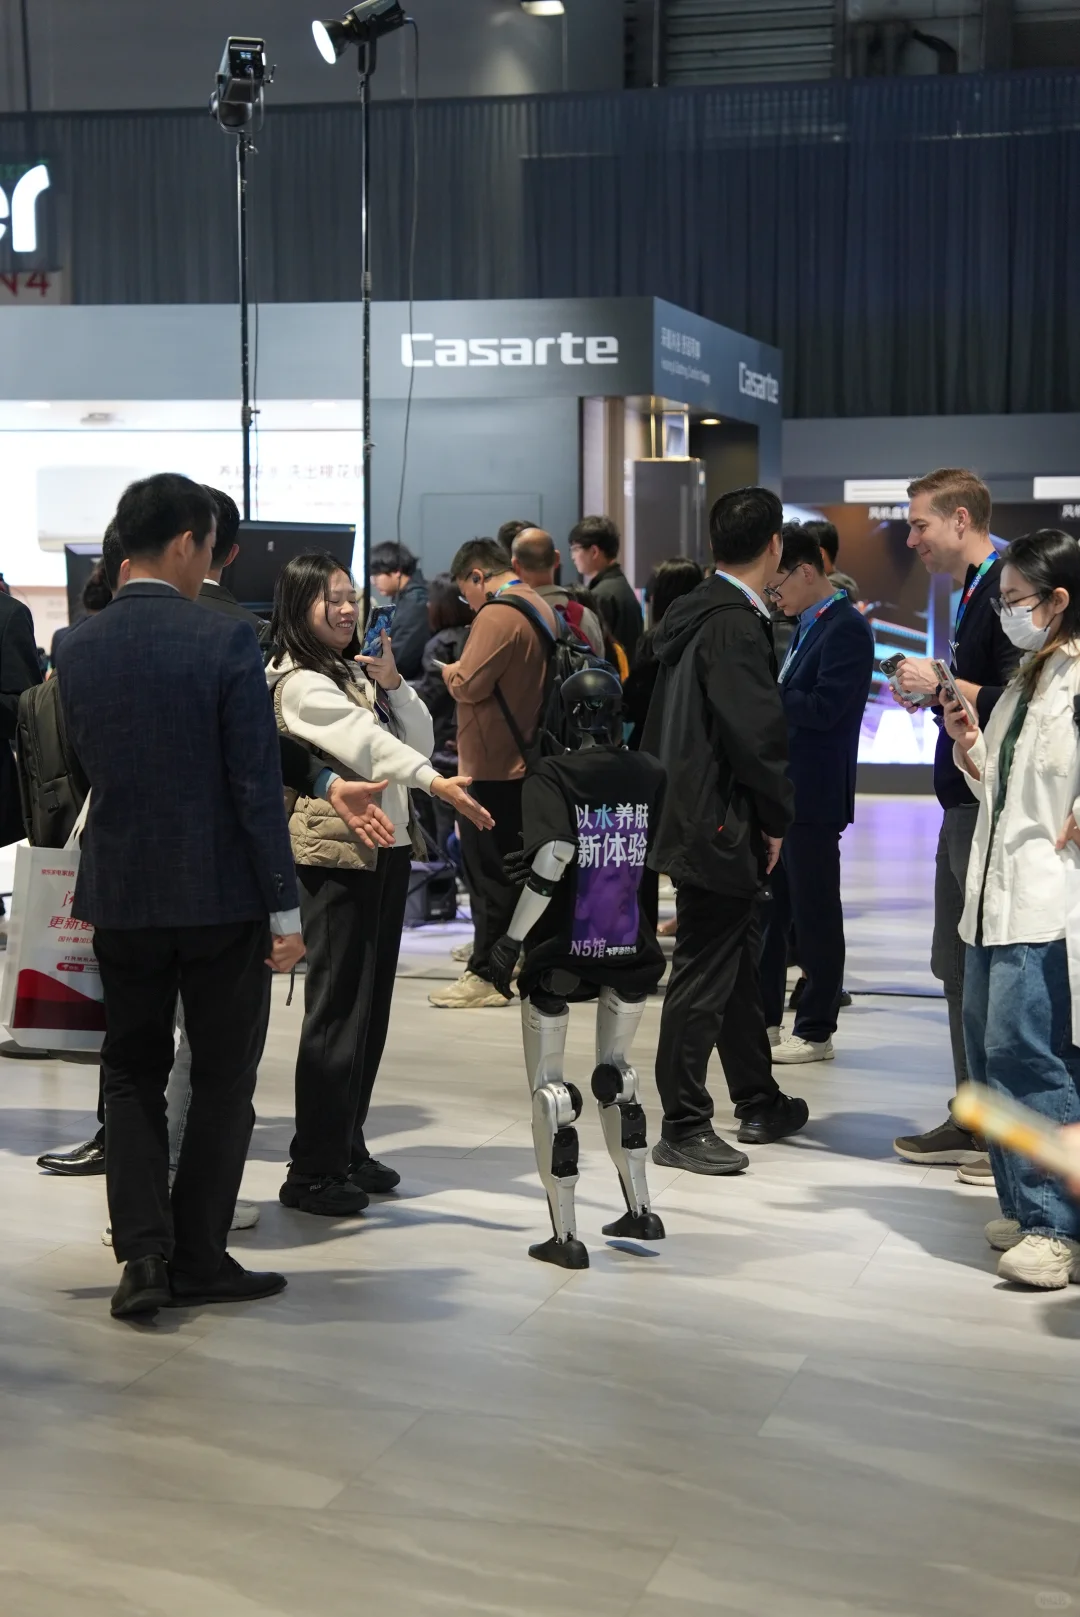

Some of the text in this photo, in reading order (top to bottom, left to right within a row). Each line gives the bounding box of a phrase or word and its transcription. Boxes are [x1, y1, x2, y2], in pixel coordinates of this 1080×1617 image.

[401, 332, 619, 367] Casarte
[738, 361, 779, 404] Casarte
[575, 803, 649, 829] 以水养肤
[577, 832, 648, 868] 新体验
[569, 937, 606, 958] N5馆
